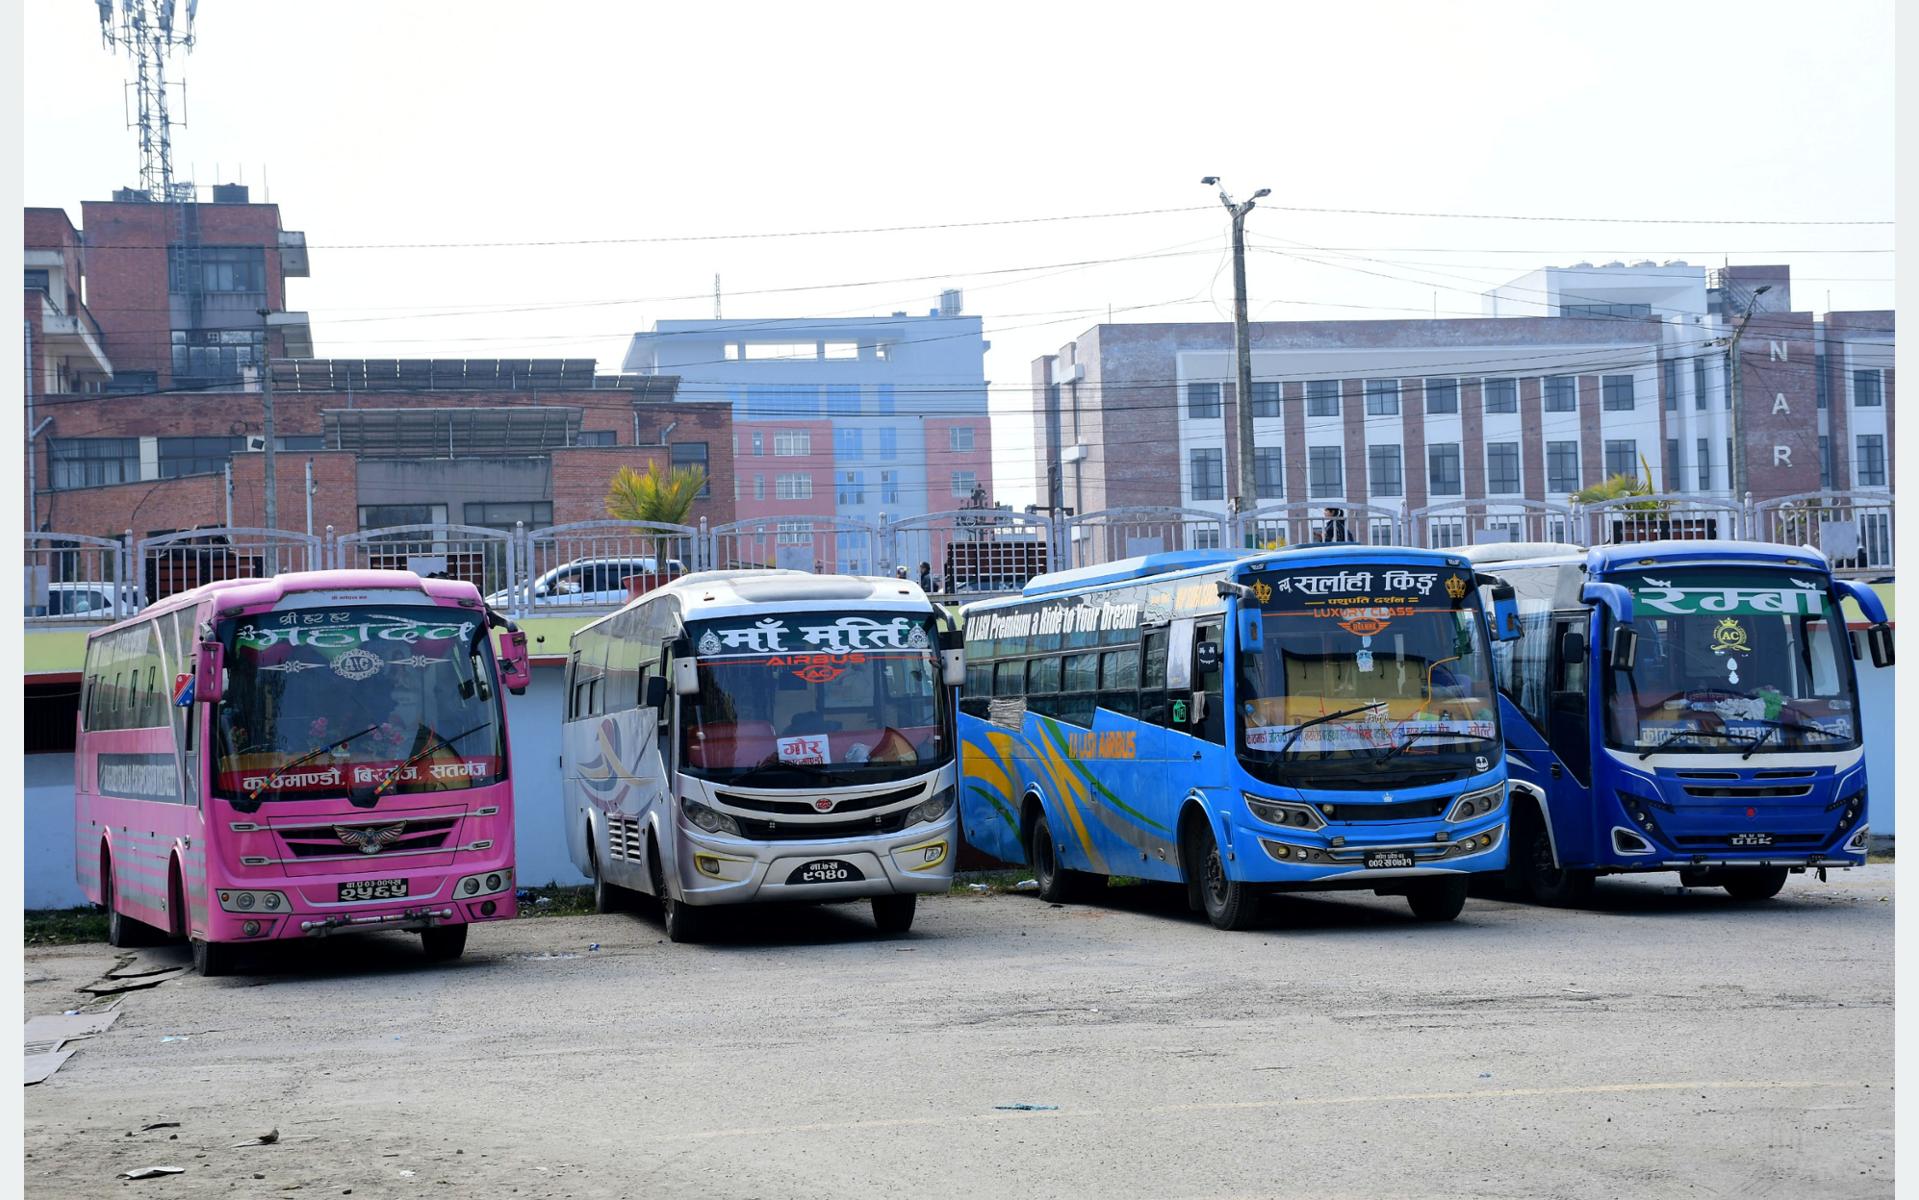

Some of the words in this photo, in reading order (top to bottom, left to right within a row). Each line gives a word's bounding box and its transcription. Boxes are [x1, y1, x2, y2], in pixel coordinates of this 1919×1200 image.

[1314, 607, 1368, 618] LUXURY
[1371, 607, 1415, 616] CLASS
[990, 611, 1032, 638] Premium
[1031, 611, 1040, 635] a
[1040, 606, 1063, 634] Ride
[1063, 607, 1075, 633] to
[1075, 603, 1101, 632] Your
[1101, 601, 1139, 630] Dream
[718, 617, 790, 652] माँ
[1722, 632, 1739, 640] AC
[766, 653, 865, 666] AIRBUS
[812, 669, 831, 677] AC
